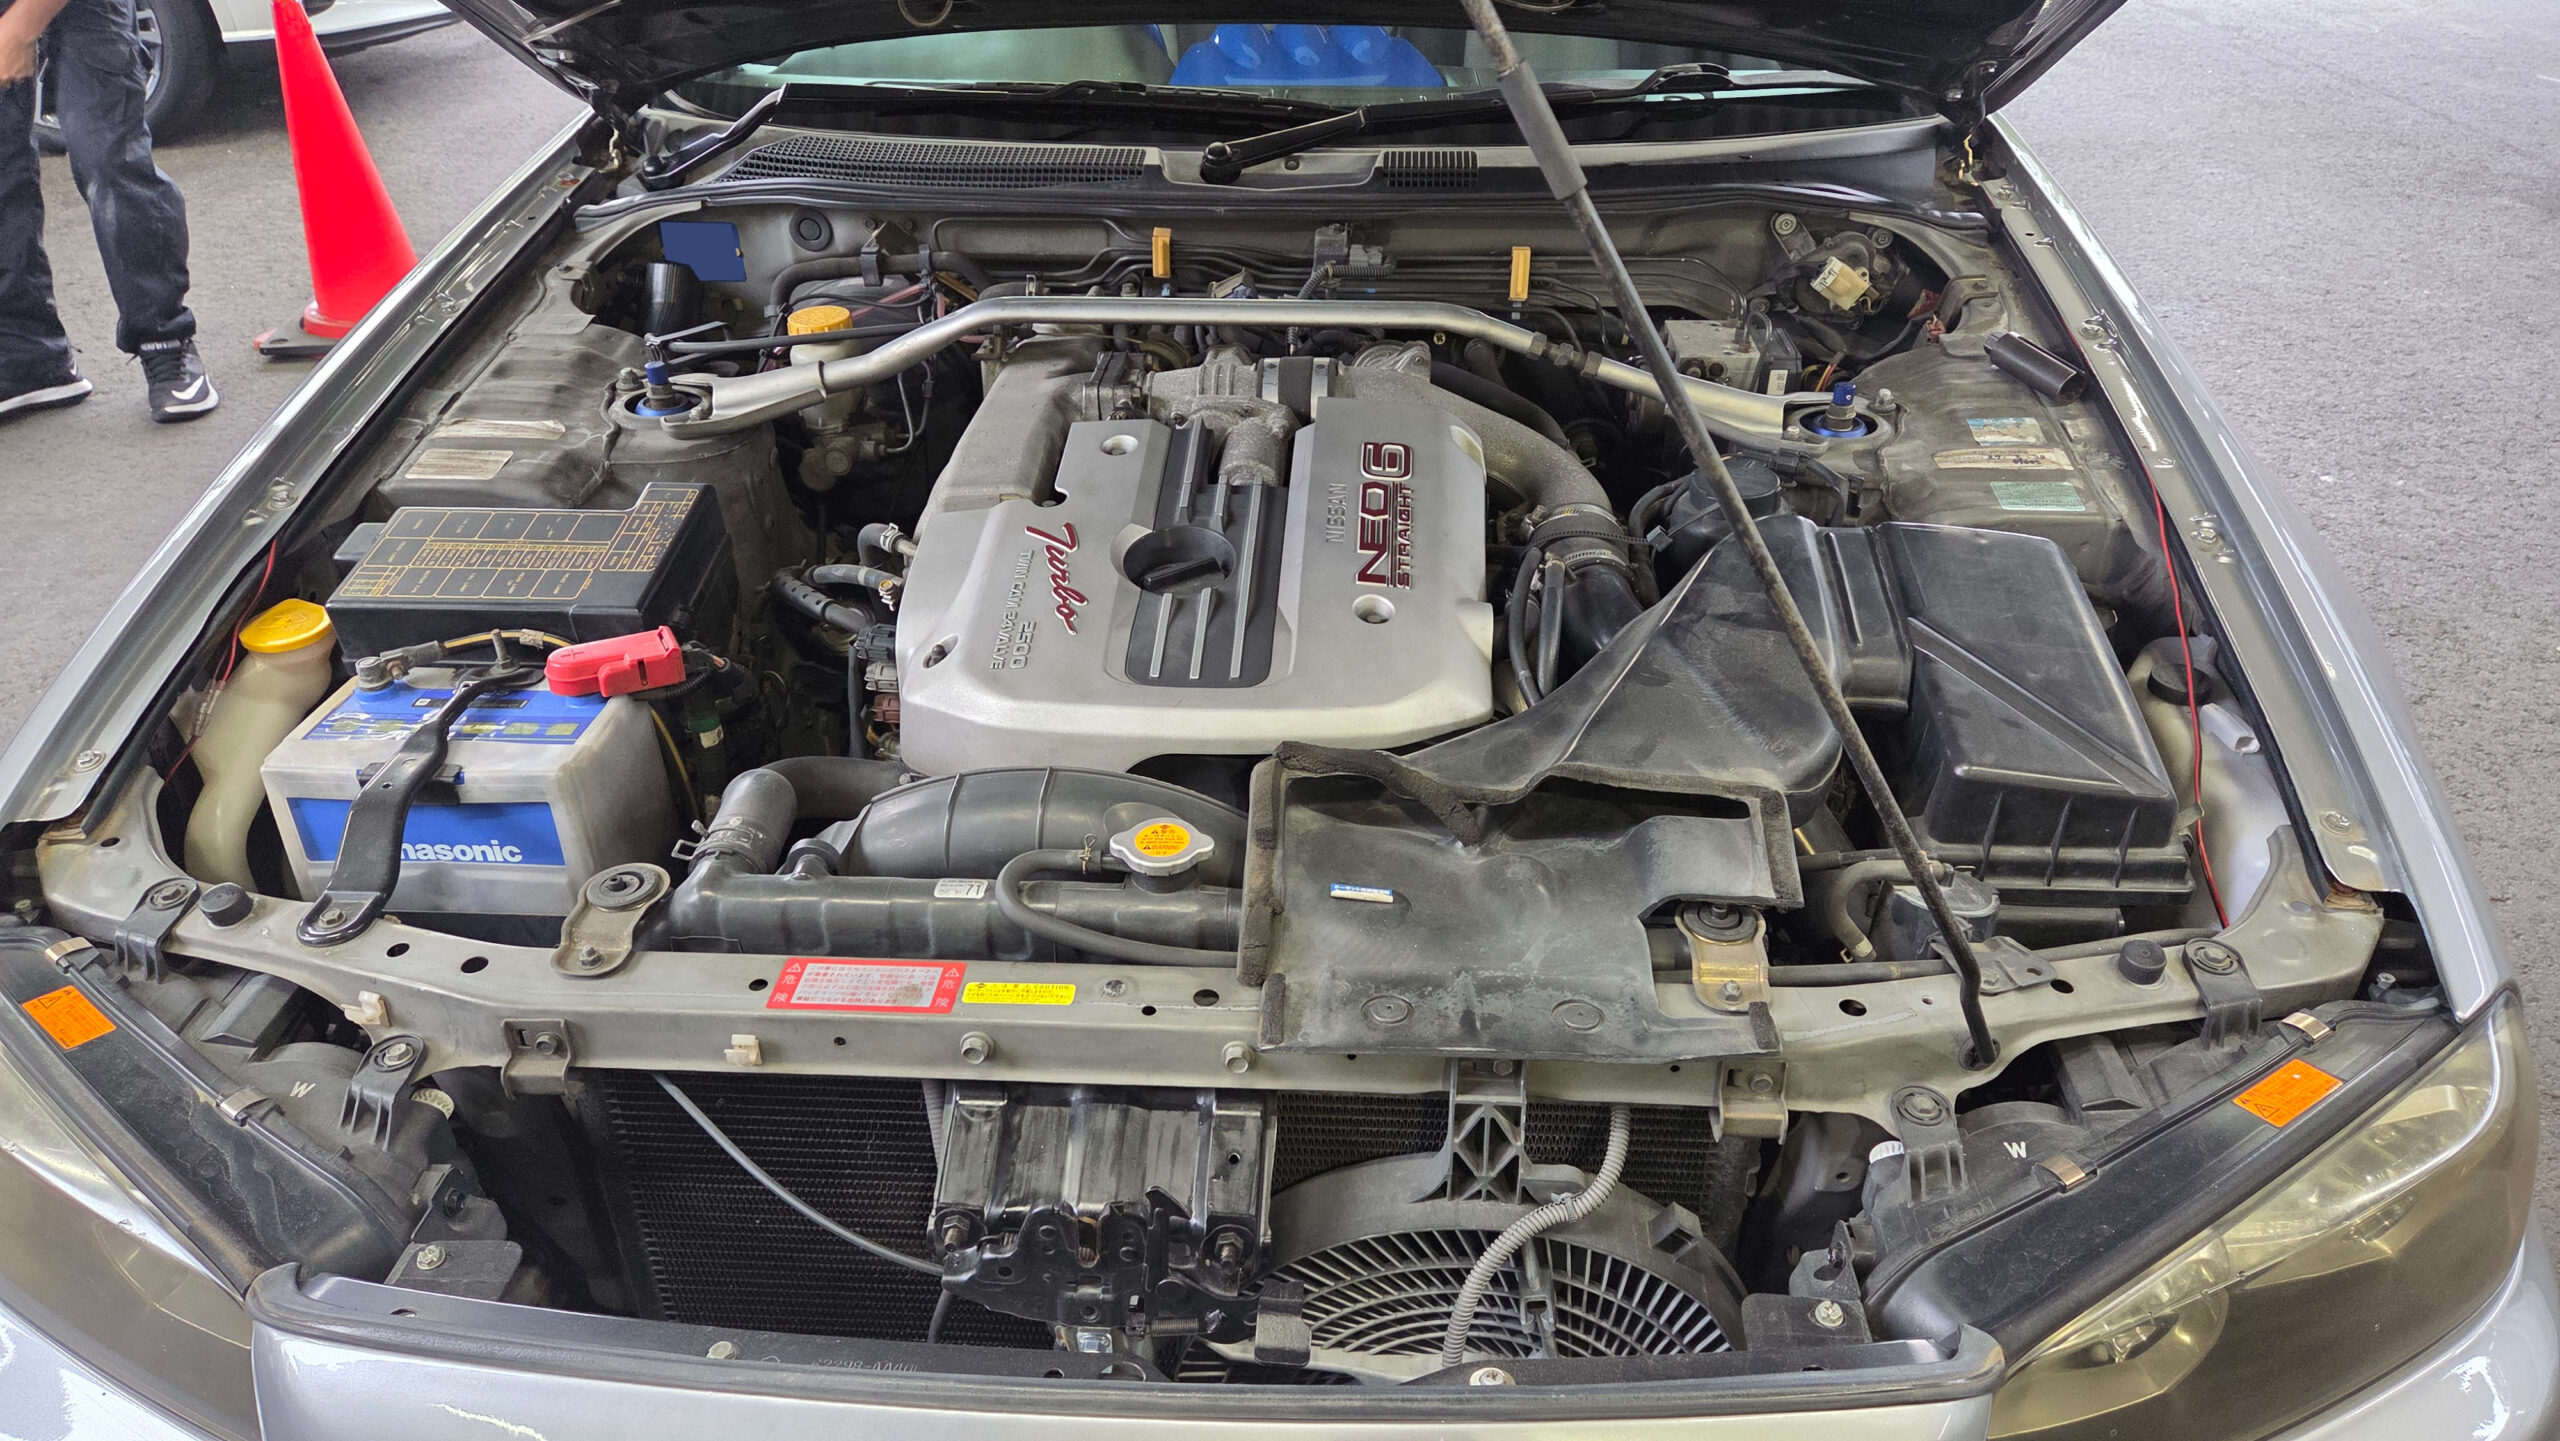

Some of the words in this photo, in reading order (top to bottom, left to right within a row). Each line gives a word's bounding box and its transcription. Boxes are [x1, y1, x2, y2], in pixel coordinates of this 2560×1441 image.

[1326, 483, 1347, 543] NISSAN
[1396, 482, 1413, 590] STRAIGHT
[1014, 549, 1035, 579] TWIN
[1025, 522, 1088, 636] Turbo
[1005, 581, 1026, 609] CAM
[1010, 620, 1037, 669] 2500
[401, 839, 523, 863] nasonic
[290, 1080, 316, 1098] W
[2002, 1141, 2027, 1158] W
